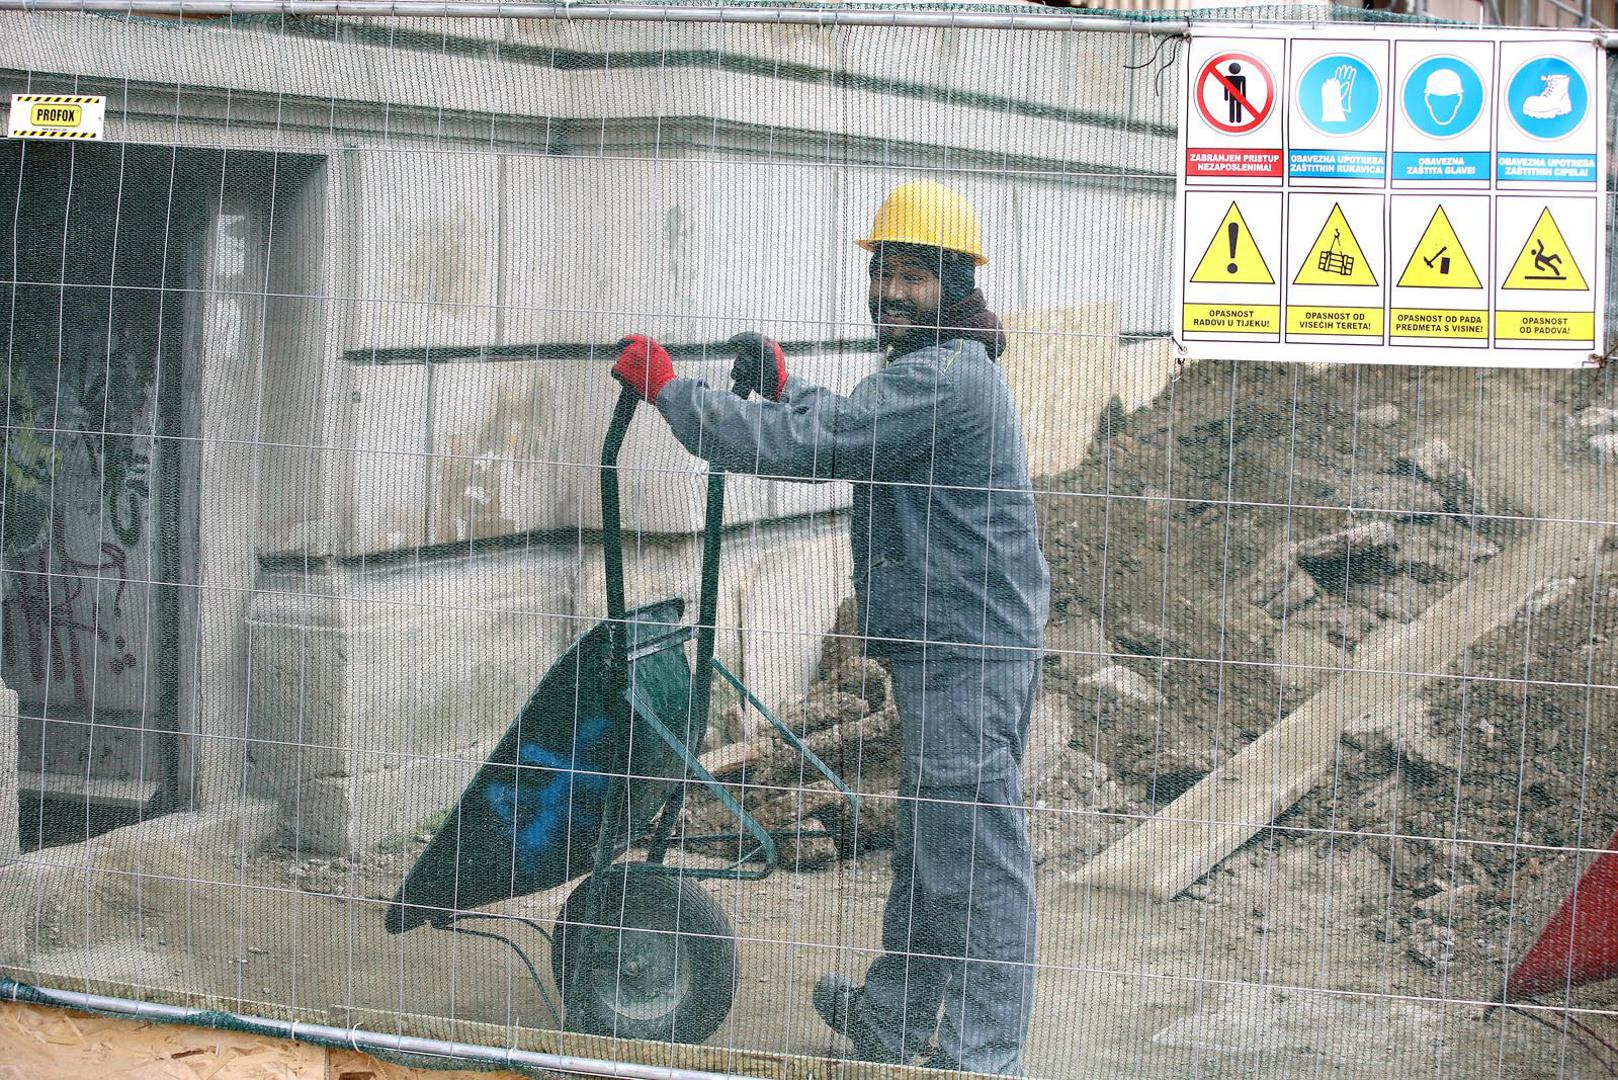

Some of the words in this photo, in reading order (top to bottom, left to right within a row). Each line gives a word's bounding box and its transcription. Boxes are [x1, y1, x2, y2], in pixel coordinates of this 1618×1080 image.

[37, 109, 75, 122] PROFOX
[1190, 154, 1241, 162] ZABRANJEN
[1243, 154, 1280, 163] PRISTUP
[1290, 155, 1336, 163] OBAVEZNA
[1337, 156, 1384, 164] UPOTREBA
[1418, 157, 1464, 165] OBAVEZNA
[1197, 163, 1271, 171] NEZAPOSLENIMA!
[1290, 163, 1335, 172] ZAŠTITNIH
[1406, 165, 1443, 174] ZAŠTITA
[1305, 312, 1350, 320] OPASNOST
[1397, 314, 1443, 322] OPASNOST
[1445, 315, 1457, 323] OD
[1522, 317, 1568, 325] OPASNOST
[1336, 322, 1371, 330] TERETA!
[1396, 323, 1442, 331] PREDMETA
[1444, 324, 1449, 332] S
[1519, 326, 1532, 334] OD
